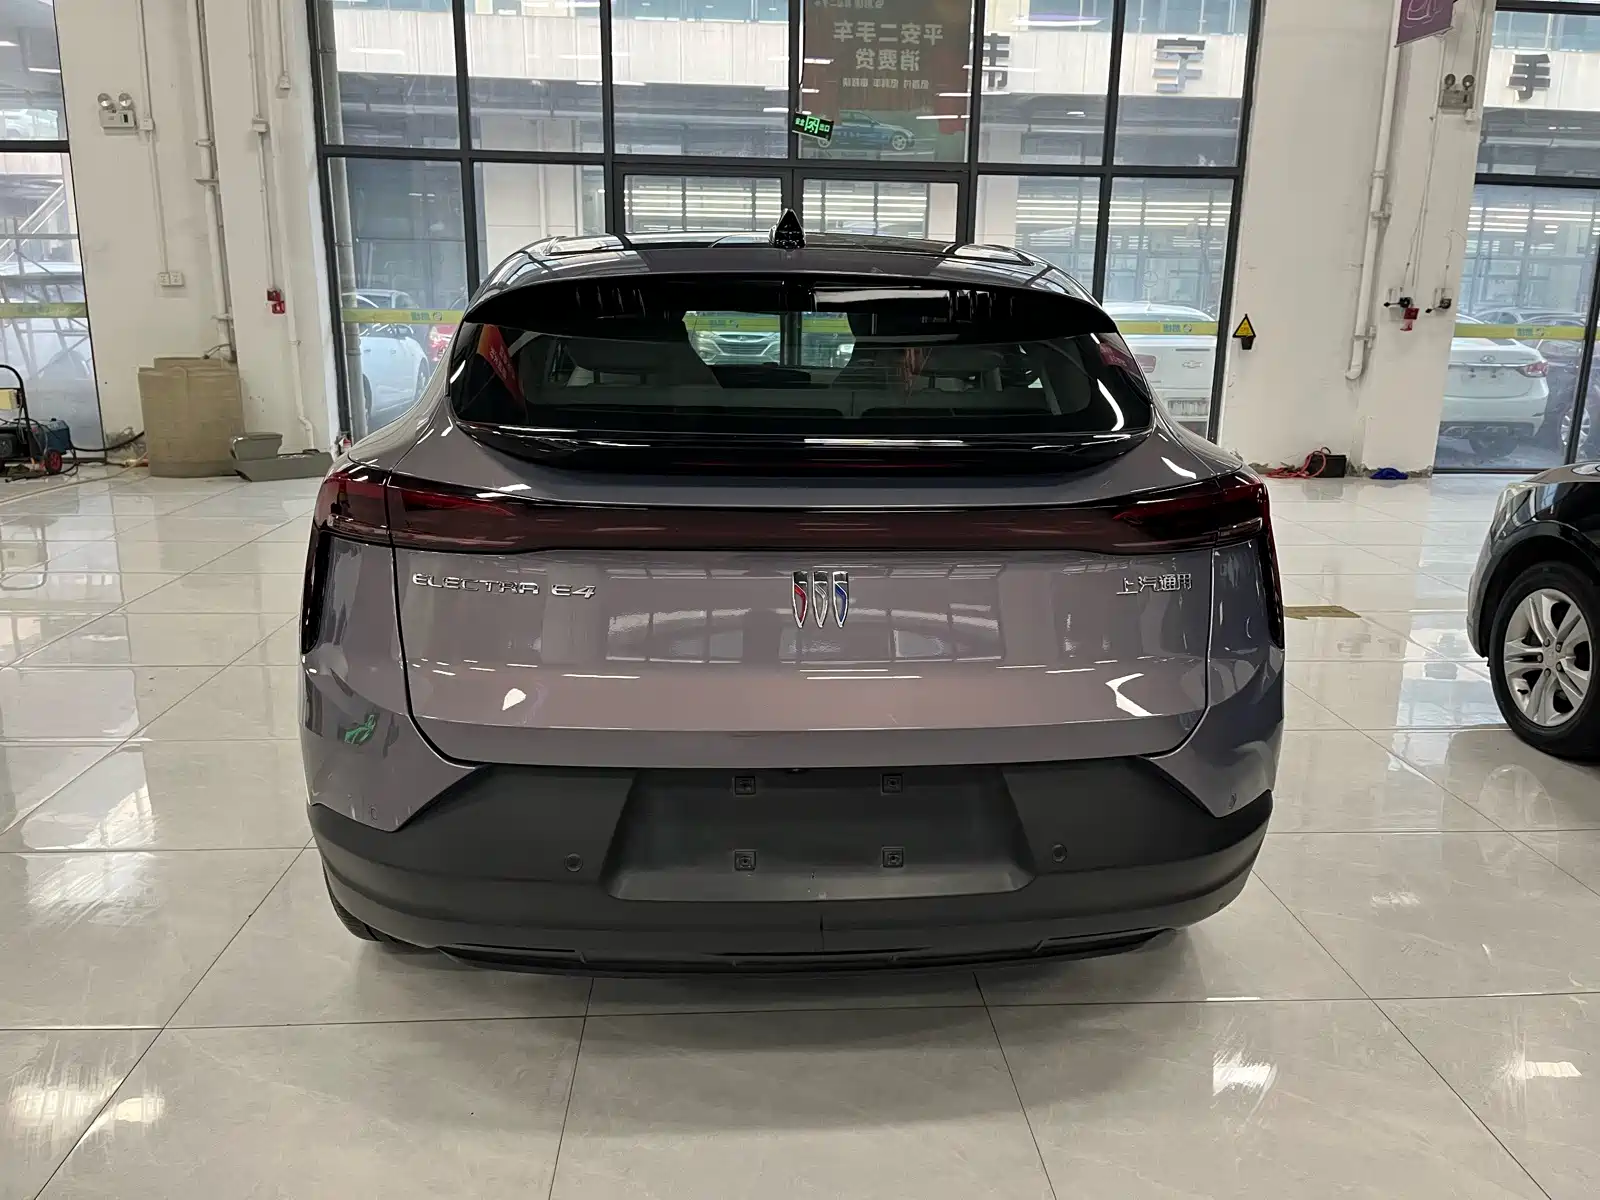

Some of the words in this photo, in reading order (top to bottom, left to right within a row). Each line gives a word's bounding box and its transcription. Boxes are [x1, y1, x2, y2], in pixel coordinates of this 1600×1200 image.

[412, 573, 540, 595] ELECTRA
[551, 584, 597, 599] E4
[1116, 573, 1192, 595] 上汽通用
